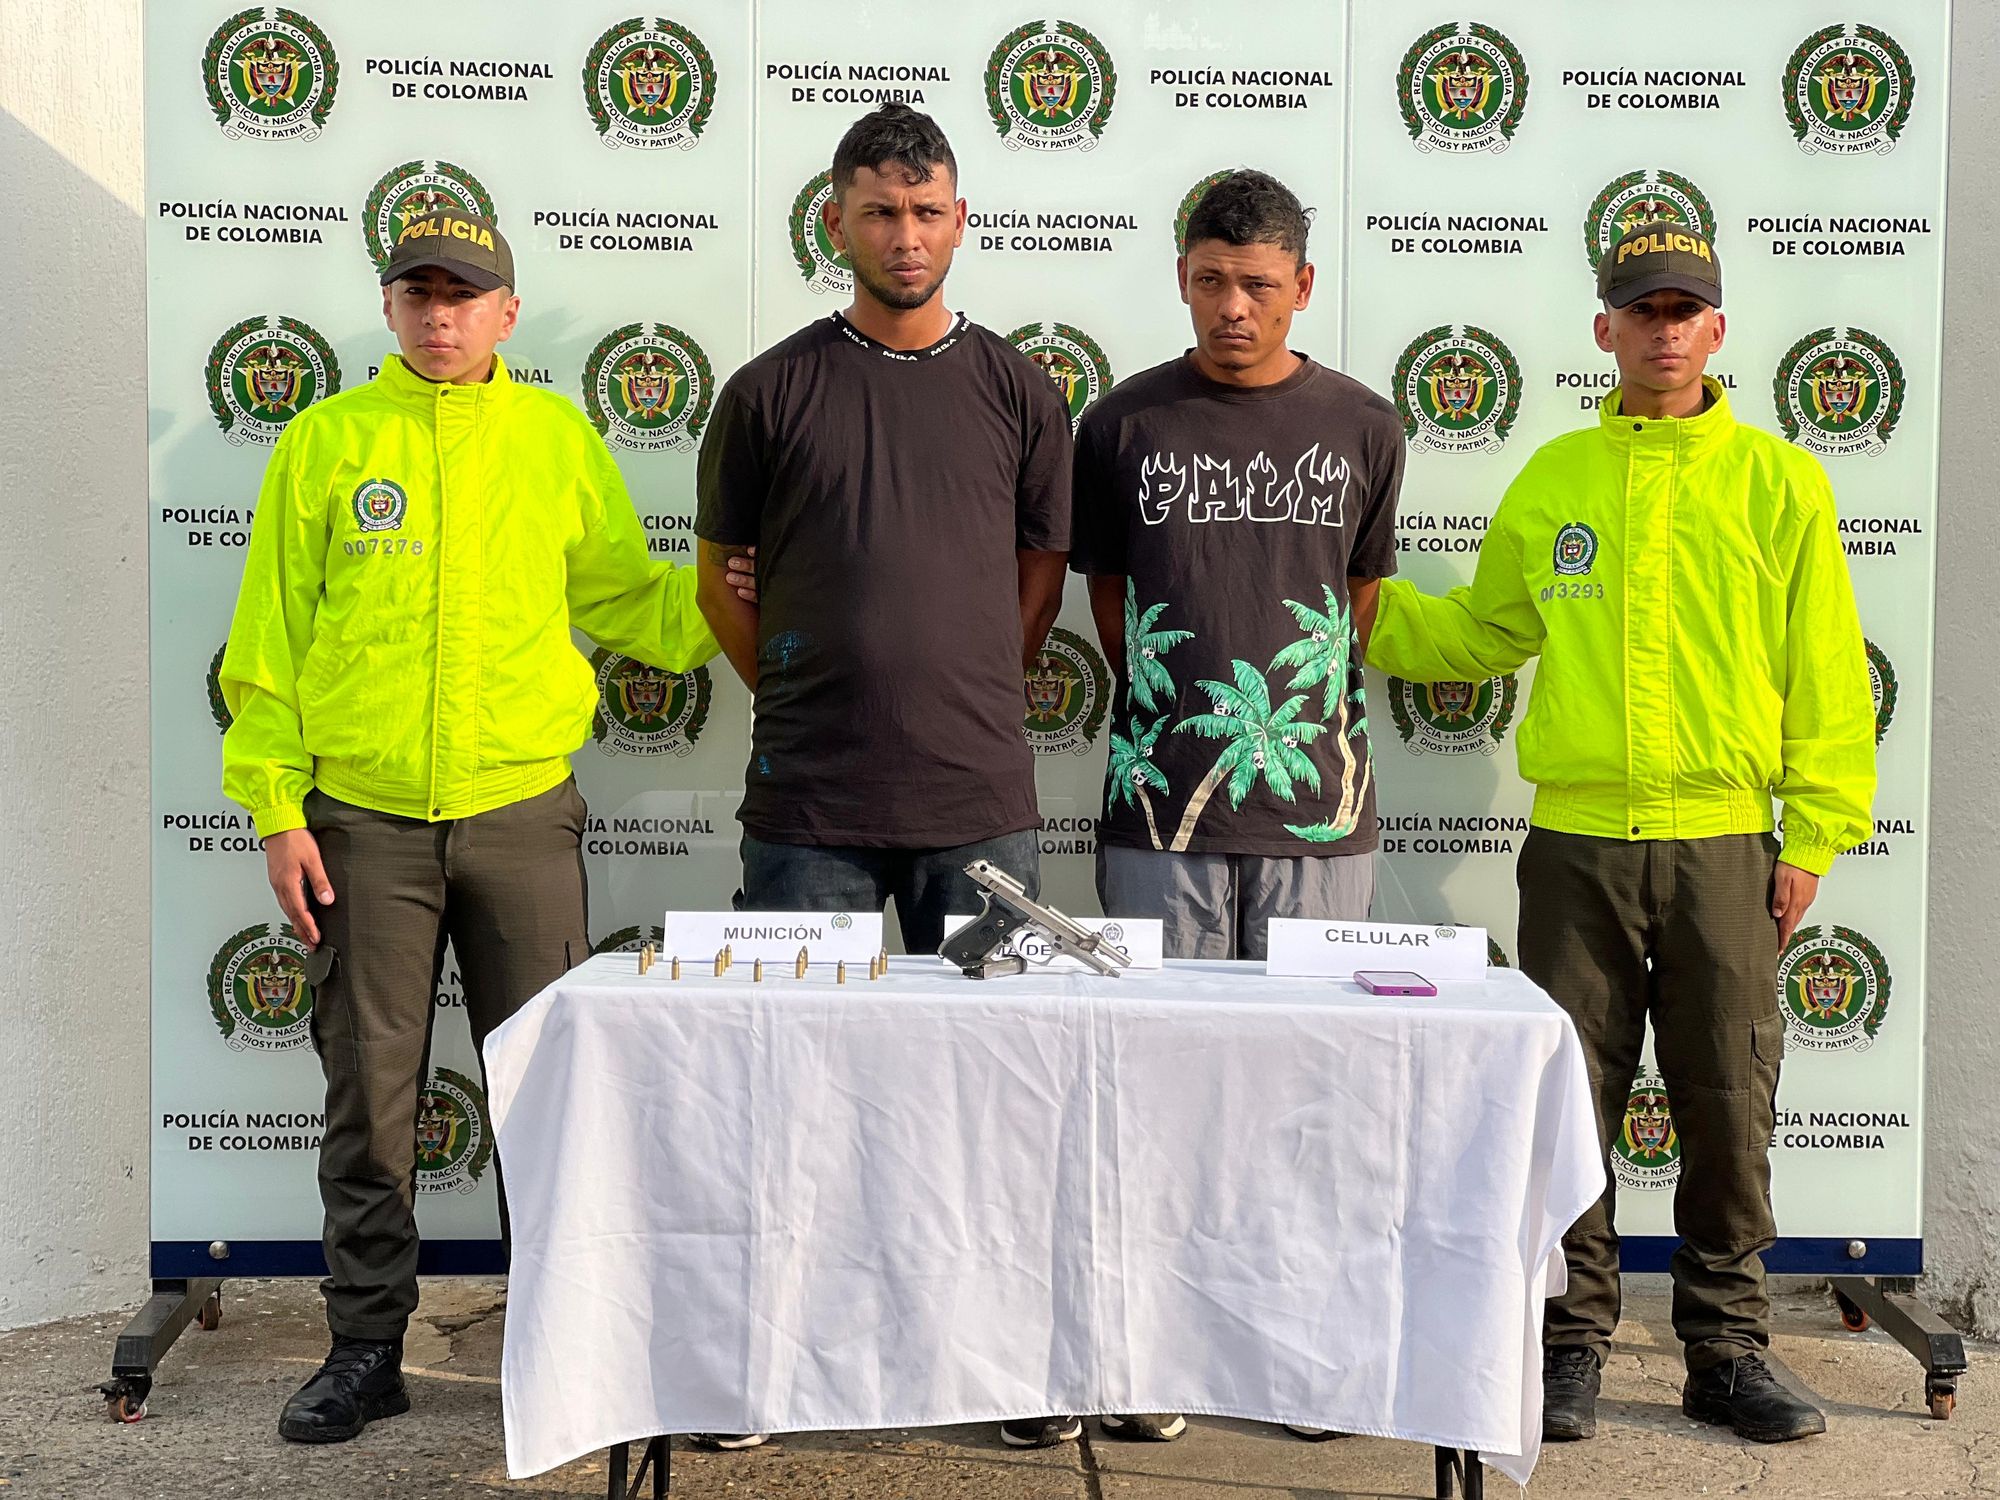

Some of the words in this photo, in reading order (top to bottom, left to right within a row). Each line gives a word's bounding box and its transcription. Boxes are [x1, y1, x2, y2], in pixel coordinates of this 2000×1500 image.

[264, 22, 280, 30] DE
[290, 29, 322, 82] COLOMBIA
[367, 56, 443, 76] POLICÍA
[450, 62, 553, 78] NACIONAL
[669, 39, 701, 92] COLOMBIA
[767, 61, 841, 79] POLICÍA
[849, 66, 950, 81] NACIONAL
[1045, 35, 1060, 43] DE
[1069, 41, 1101, 94] COLOMBIA
[1482, 43, 1513, 95] COLOMBIA
[1868, 44, 1899, 97] COLOMBIA
[1151, 66, 1225, 85] POLICÍA
[1232, 71, 1332, 85] NACIONAL
[1563, 67, 1637, 85] POLICÍA
[1645, 72, 1745, 86] NACIONAL
[393, 83, 416, 97] DE
[424, 84, 527, 100] COLOMBIA
[792, 88, 815, 102] DE
[823, 88, 925, 104] COLOMBIA
[1176, 93, 1198, 107] DE
[1206, 93, 1307, 108] COLOMBIA
[1588, 94, 1610, 108] DE
[1618, 94, 1719, 108] COLOMBIA
[272, 95, 318, 125] NACIONAL
[650, 104, 696, 134] NACIONAL
[1051, 106, 1096, 136] NACIONAL
[1463, 108, 1507, 137] NACIONAL
[1848, 109, 1893, 139] NACIONAL
[272, 124, 307, 138] PATRIA
[650, 133, 685, 147] PATRIA
[1051, 134, 1084, 148] PATRIA
[1462, 136, 1496, 150] PATRIA
[1847, 138, 1881, 151] PATRIA
[160, 200, 237, 218] POLICÍA
[245, 205, 348, 221] NACIONAL
[535, 208, 609, 227] POLICÍA
[617, 214, 718, 228] NACIONAL
[967, 210, 1030, 228] OLICÍA
[1038, 215, 1137, 229] NACIONAL
[1670, 190, 1699, 231] COLOMB
[1367, 212, 1440, 230] POLICÍA
[1448, 217, 1548, 231] NACIONAL
[1748, 214, 1822, 232] POLICÍA
[1830, 219, 1930, 233] NACIONAL
[186, 226, 209, 240] DE
[218, 227, 322, 243] COLOMBIA
[398, 217, 494, 252] POLICIA
[560, 235, 583, 249] DE
[591, 236, 692, 251] COLOMBIA
[981, 236, 1003, 250] DE
[1011, 237, 1112, 251] COLOMBIA
[1392, 239, 1414, 252] DE
[1422, 239, 1522, 253] COLOMBIA
[1617, 233, 1711, 264] POLICIA
[1773, 241, 1796, 254] DE
[1803, 241, 1904, 255] COLOMBIA
[293, 337, 325, 390] COLOMBIA
[667, 343, 699, 395] COLOMBIA
[1066, 343, 1098, 394] COLOMBIA
[1476, 345, 1507, 397] COLOMBIA
[1858, 347, 1890, 399] COLOMBIA
[1556, 369, 1616, 388] POLICÍ
[649, 408, 693, 437] NACIONAL
[1457, 409, 1501, 438] NACIONAL
[1839, 412, 1884, 441] NACIONAL
[648, 436, 682, 449] PATRIA
[1457, 437, 1490, 450] PATRIA
[1838, 439, 1872, 453] PATRIA
[1139, 442, 1351, 527] PALM
[163, 505, 239, 523] POLICÍA
[1397, 511, 1437, 530] ICÍA
[1838, 519, 1922, 533] ACIONAL
[189, 532, 212, 545] DE
[343, 538, 423, 556] 007278
[1417, 538, 1483, 552] COLOM
[1063, 647, 1095, 699] COLOMBIA
[647, 712, 691, 741] NACIONAL
[1045, 711, 1089, 740] NACIONAL
[1453, 711, 1497, 740] NACIONAL
[647, 740, 680, 753] PATRIA
[1045, 739, 1078, 752] PATRIA
[1453, 739, 1486, 752] PATRIA
[164, 811, 240, 829] POLICÍA
[614, 819, 713, 833] NACIONAL
[1439, 817, 1528, 831] NACIONA
[190, 838, 213, 851] DE
[588, 841, 688, 855] COLOMBIA
[1384, 839, 1406, 852] DE
[1413, 839, 1512, 853] COLOMBIA
[723, 924, 822, 940] MUNICIÓN
[1325, 929, 1430, 947] CELULAR
[1845, 945, 1876, 996] COLOMBIA
[1826, 1008, 1870, 1036] NACIONAL
[1826, 1035, 1859, 1048] PATRIA
[164, 1110, 239, 1128] POLICÍA
[247, 1114, 324, 1128] NACION
[448, 1087, 480, 1138] COLOMBIA
[1810, 1113, 1909, 1127] NACIONAL
[189, 1137, 212, 1150] DE
[220, 1136, 321, 1150] COLOMBIA
[1784, 1134, 1884, 1148] COLOMBIA
[430, 1150, 475, 1179] NACIONAL
[430, 1177, 464, 1191] PATRIA
